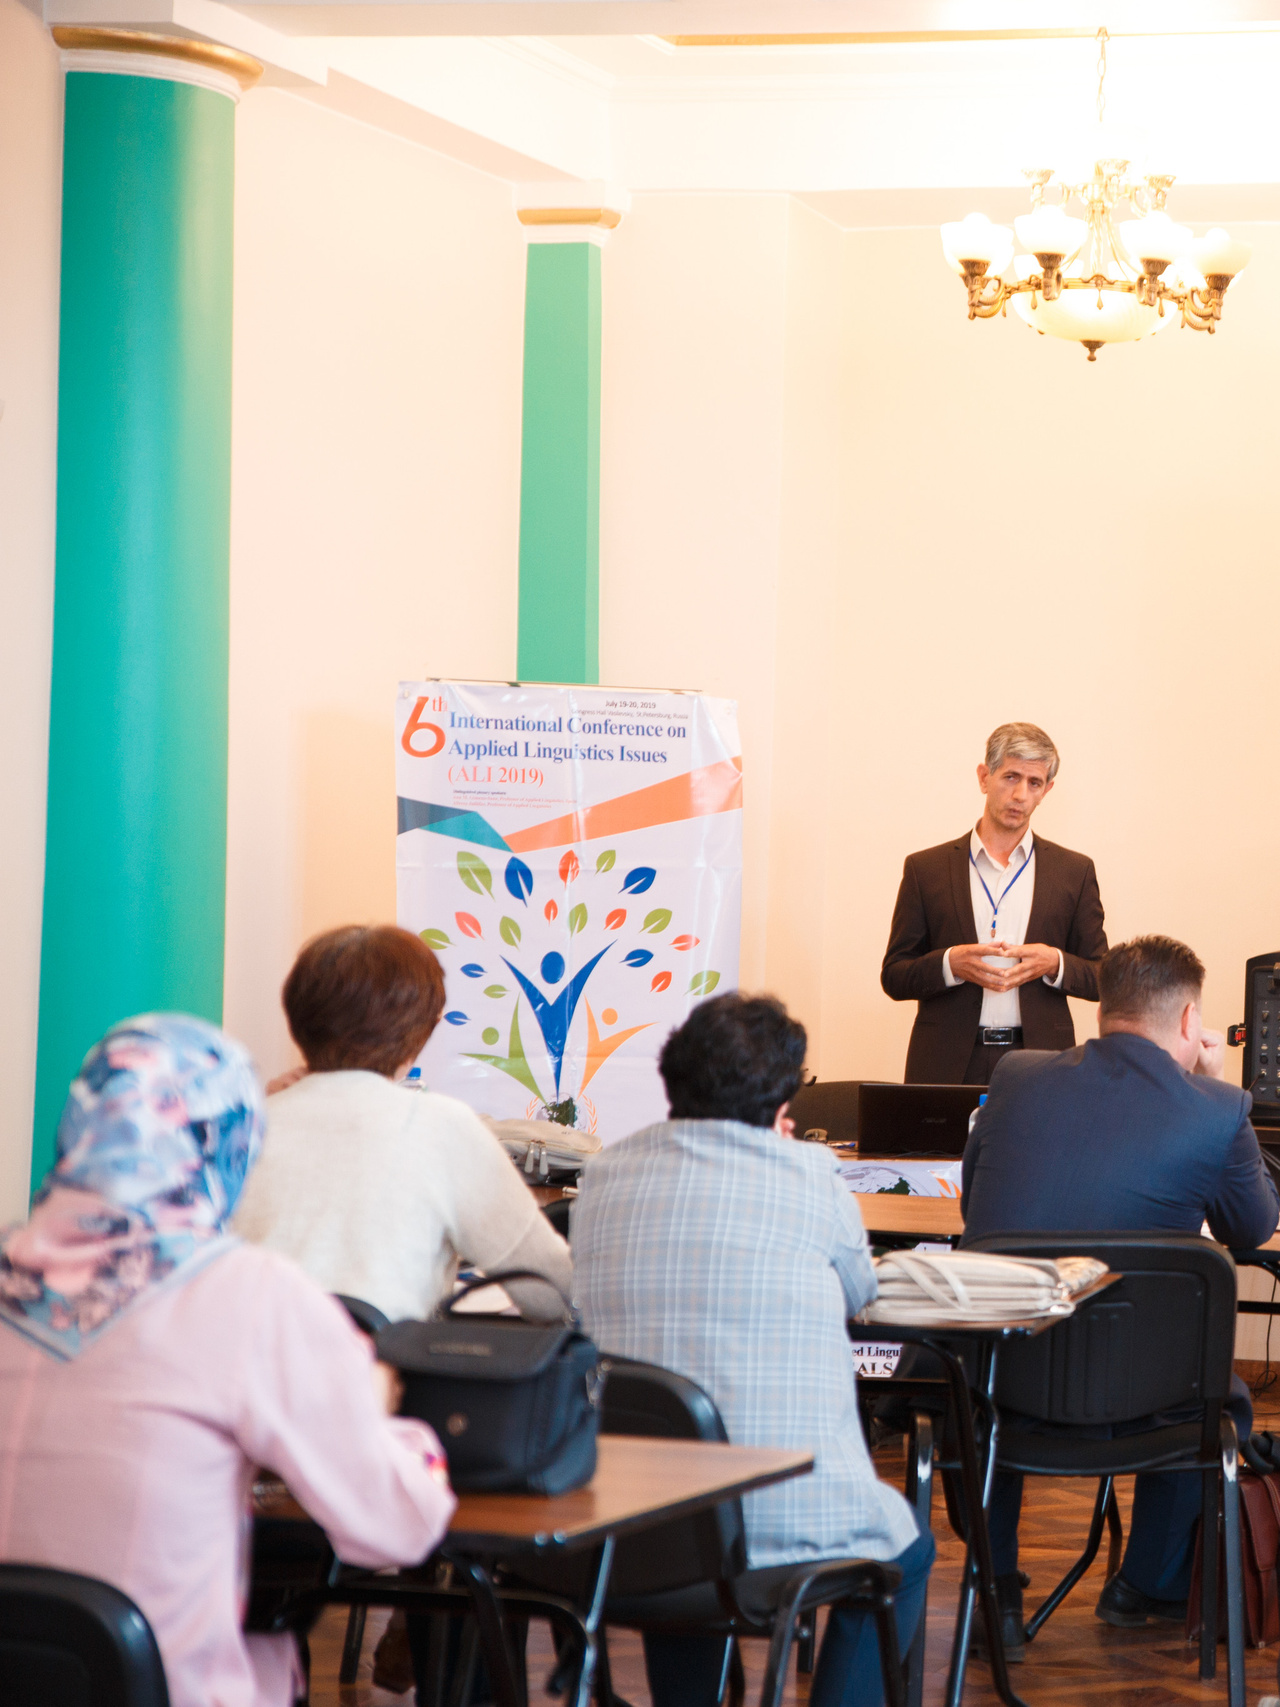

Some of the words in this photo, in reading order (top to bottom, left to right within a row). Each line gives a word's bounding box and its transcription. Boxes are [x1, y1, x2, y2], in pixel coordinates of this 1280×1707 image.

[605, 700, 617, 709] July
[619, 700, 639, 709] 19-20,
[640, 701, 657, 709] 2019
[449, 711, 562, 733] International
[567, 716, 663, 737] Conference
[668, 725, 687, 738] on
[448, 739, 518, 760] Applied
[524, 741, 614, 763] Linguistics
[620, 745, 668, 763] Issues
[448, 765, 492, 785] (ALI
[498, 766, 544, 788] 2019)
[856, 1362, 895, 1376] ALS
